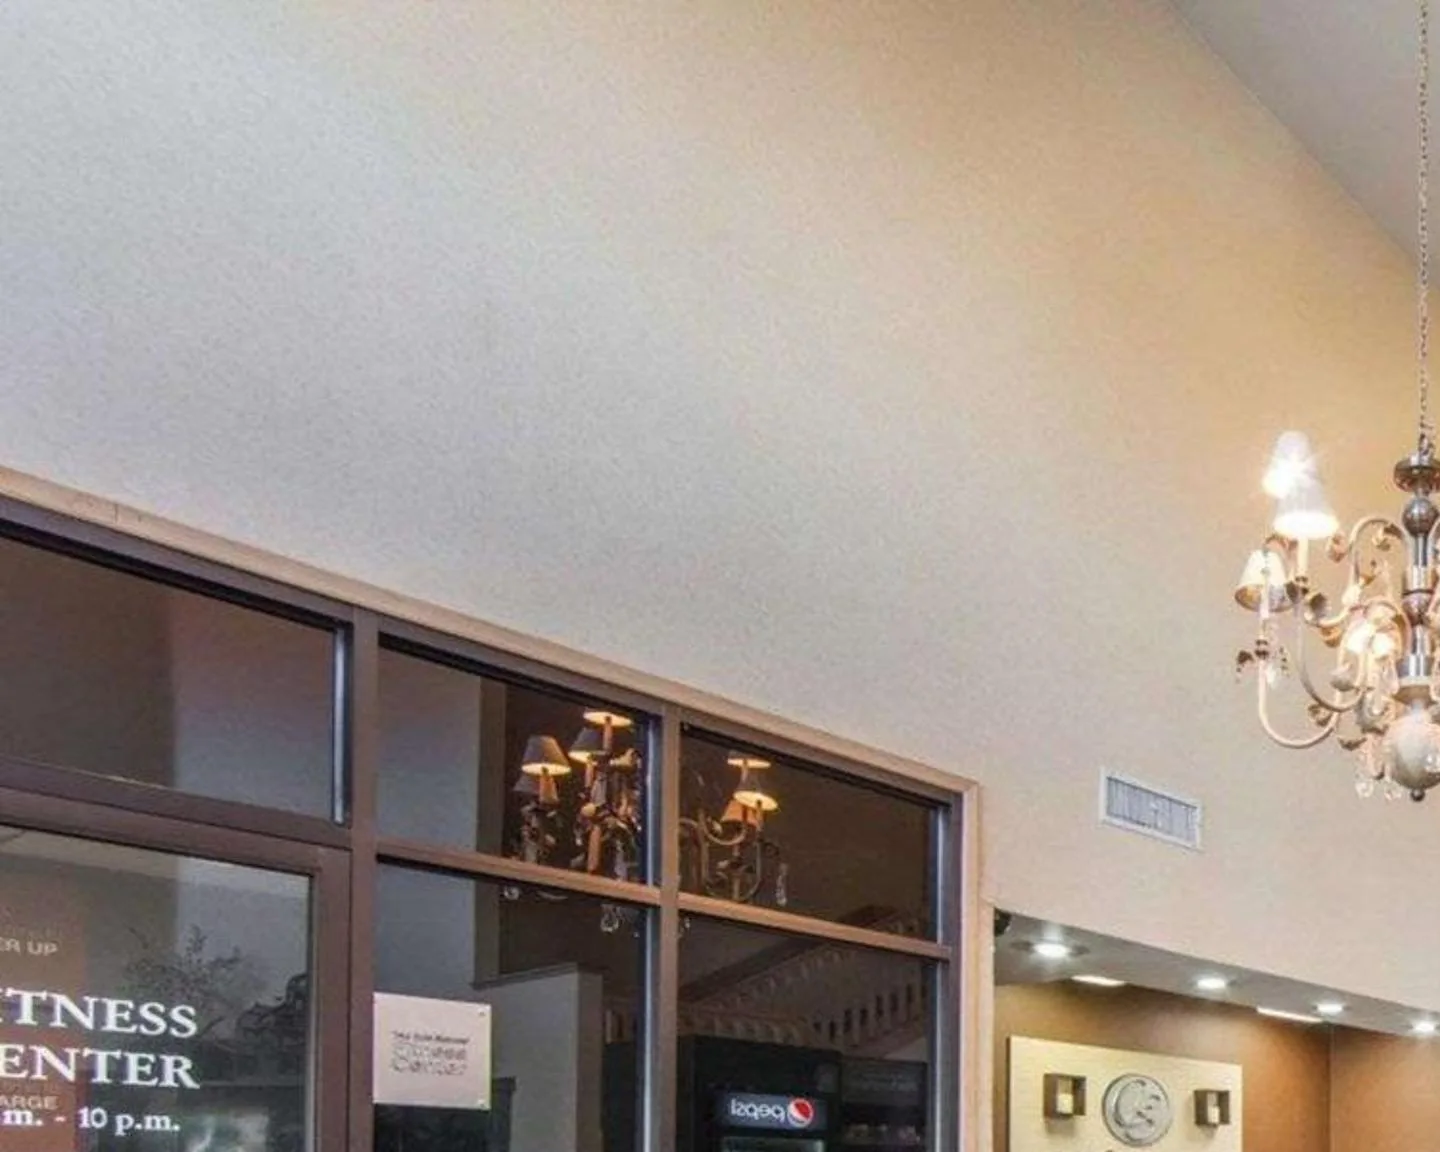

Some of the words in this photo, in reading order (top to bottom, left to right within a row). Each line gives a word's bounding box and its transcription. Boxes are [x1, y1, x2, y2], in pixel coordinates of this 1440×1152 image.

[27, 939, 58, 955] UP
[0, 987, 198, 1038] TNESS
[78, 1106, 108, 1129] 10
[114, 1112, 180, 1137] p.m.
